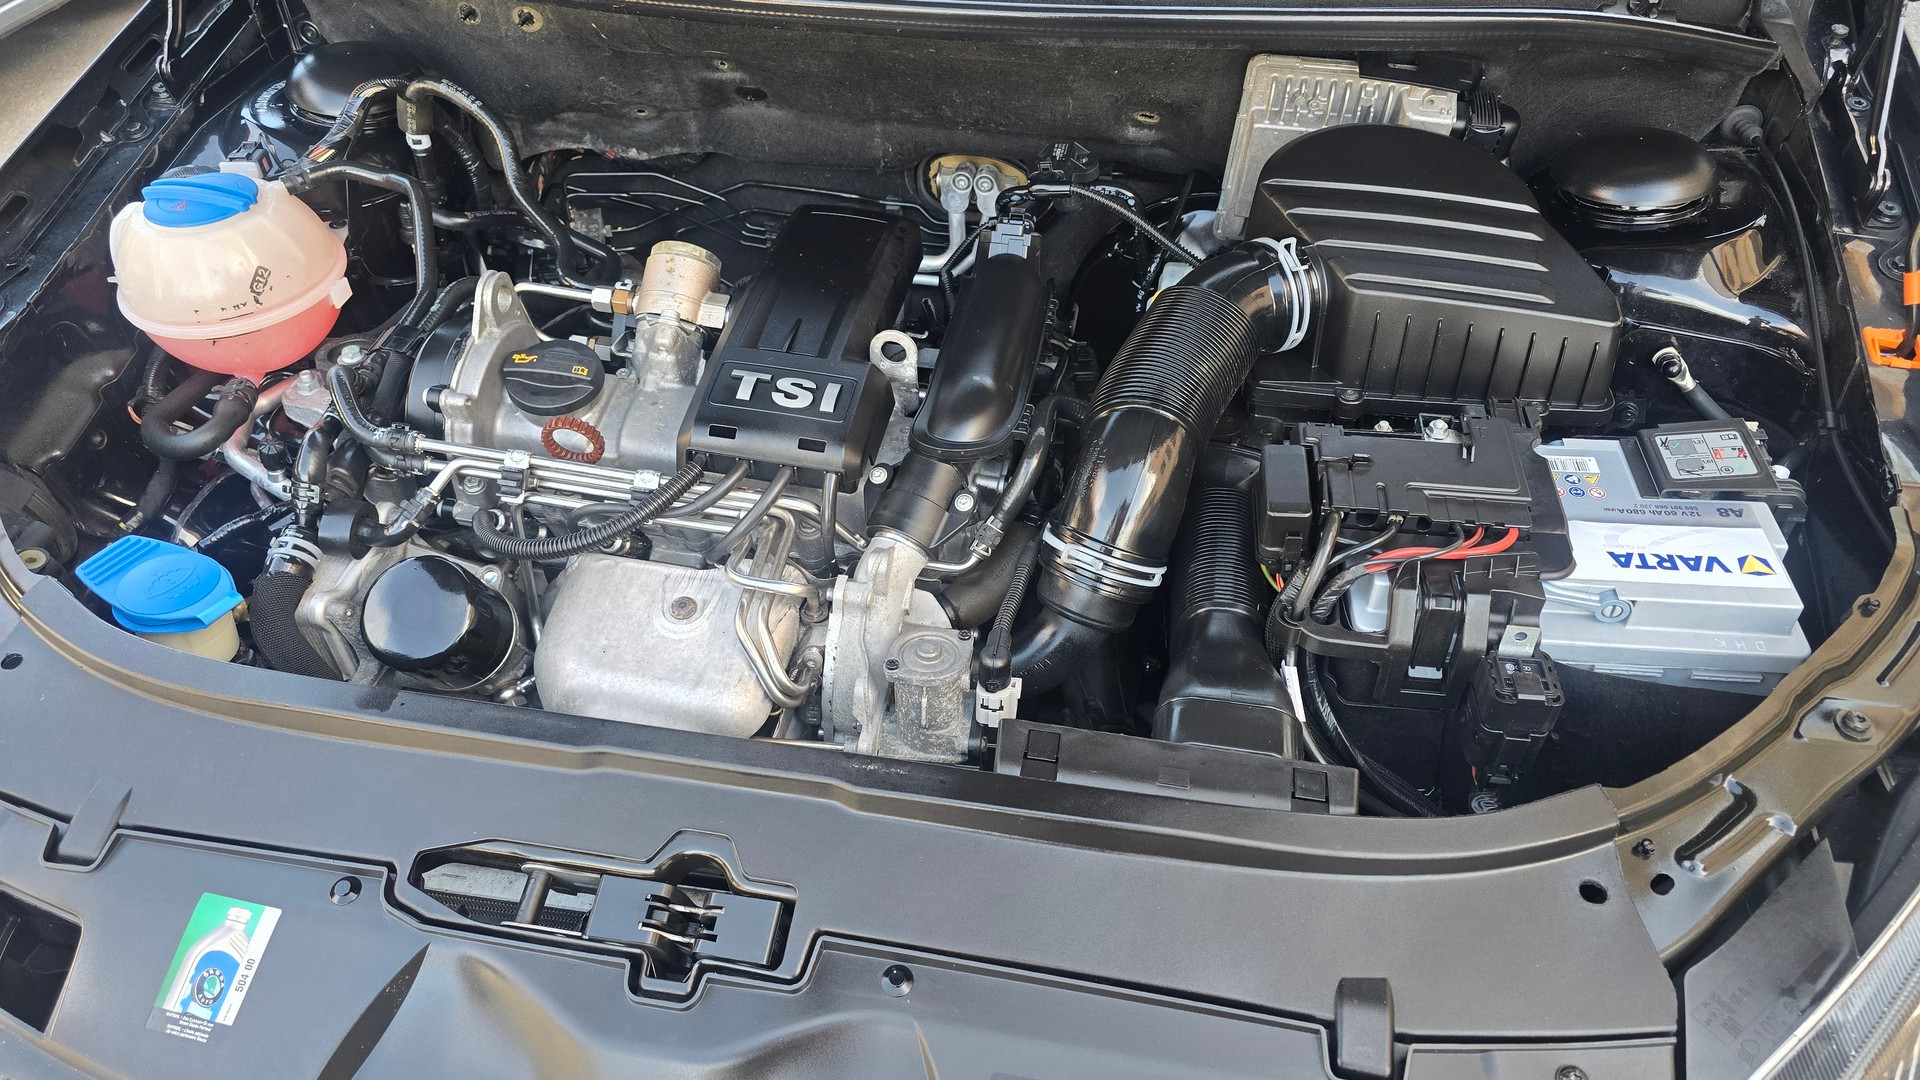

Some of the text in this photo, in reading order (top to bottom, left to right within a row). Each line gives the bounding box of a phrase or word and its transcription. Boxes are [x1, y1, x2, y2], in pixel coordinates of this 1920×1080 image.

[731, 369, 841, 413] TSI
[1716, 507, 1744, 518] A8
[1606, 551, 1733, 573] VARTA
[235, 958, 256, 993] 504 00
[197, 993, 214, 1005] AUTO
